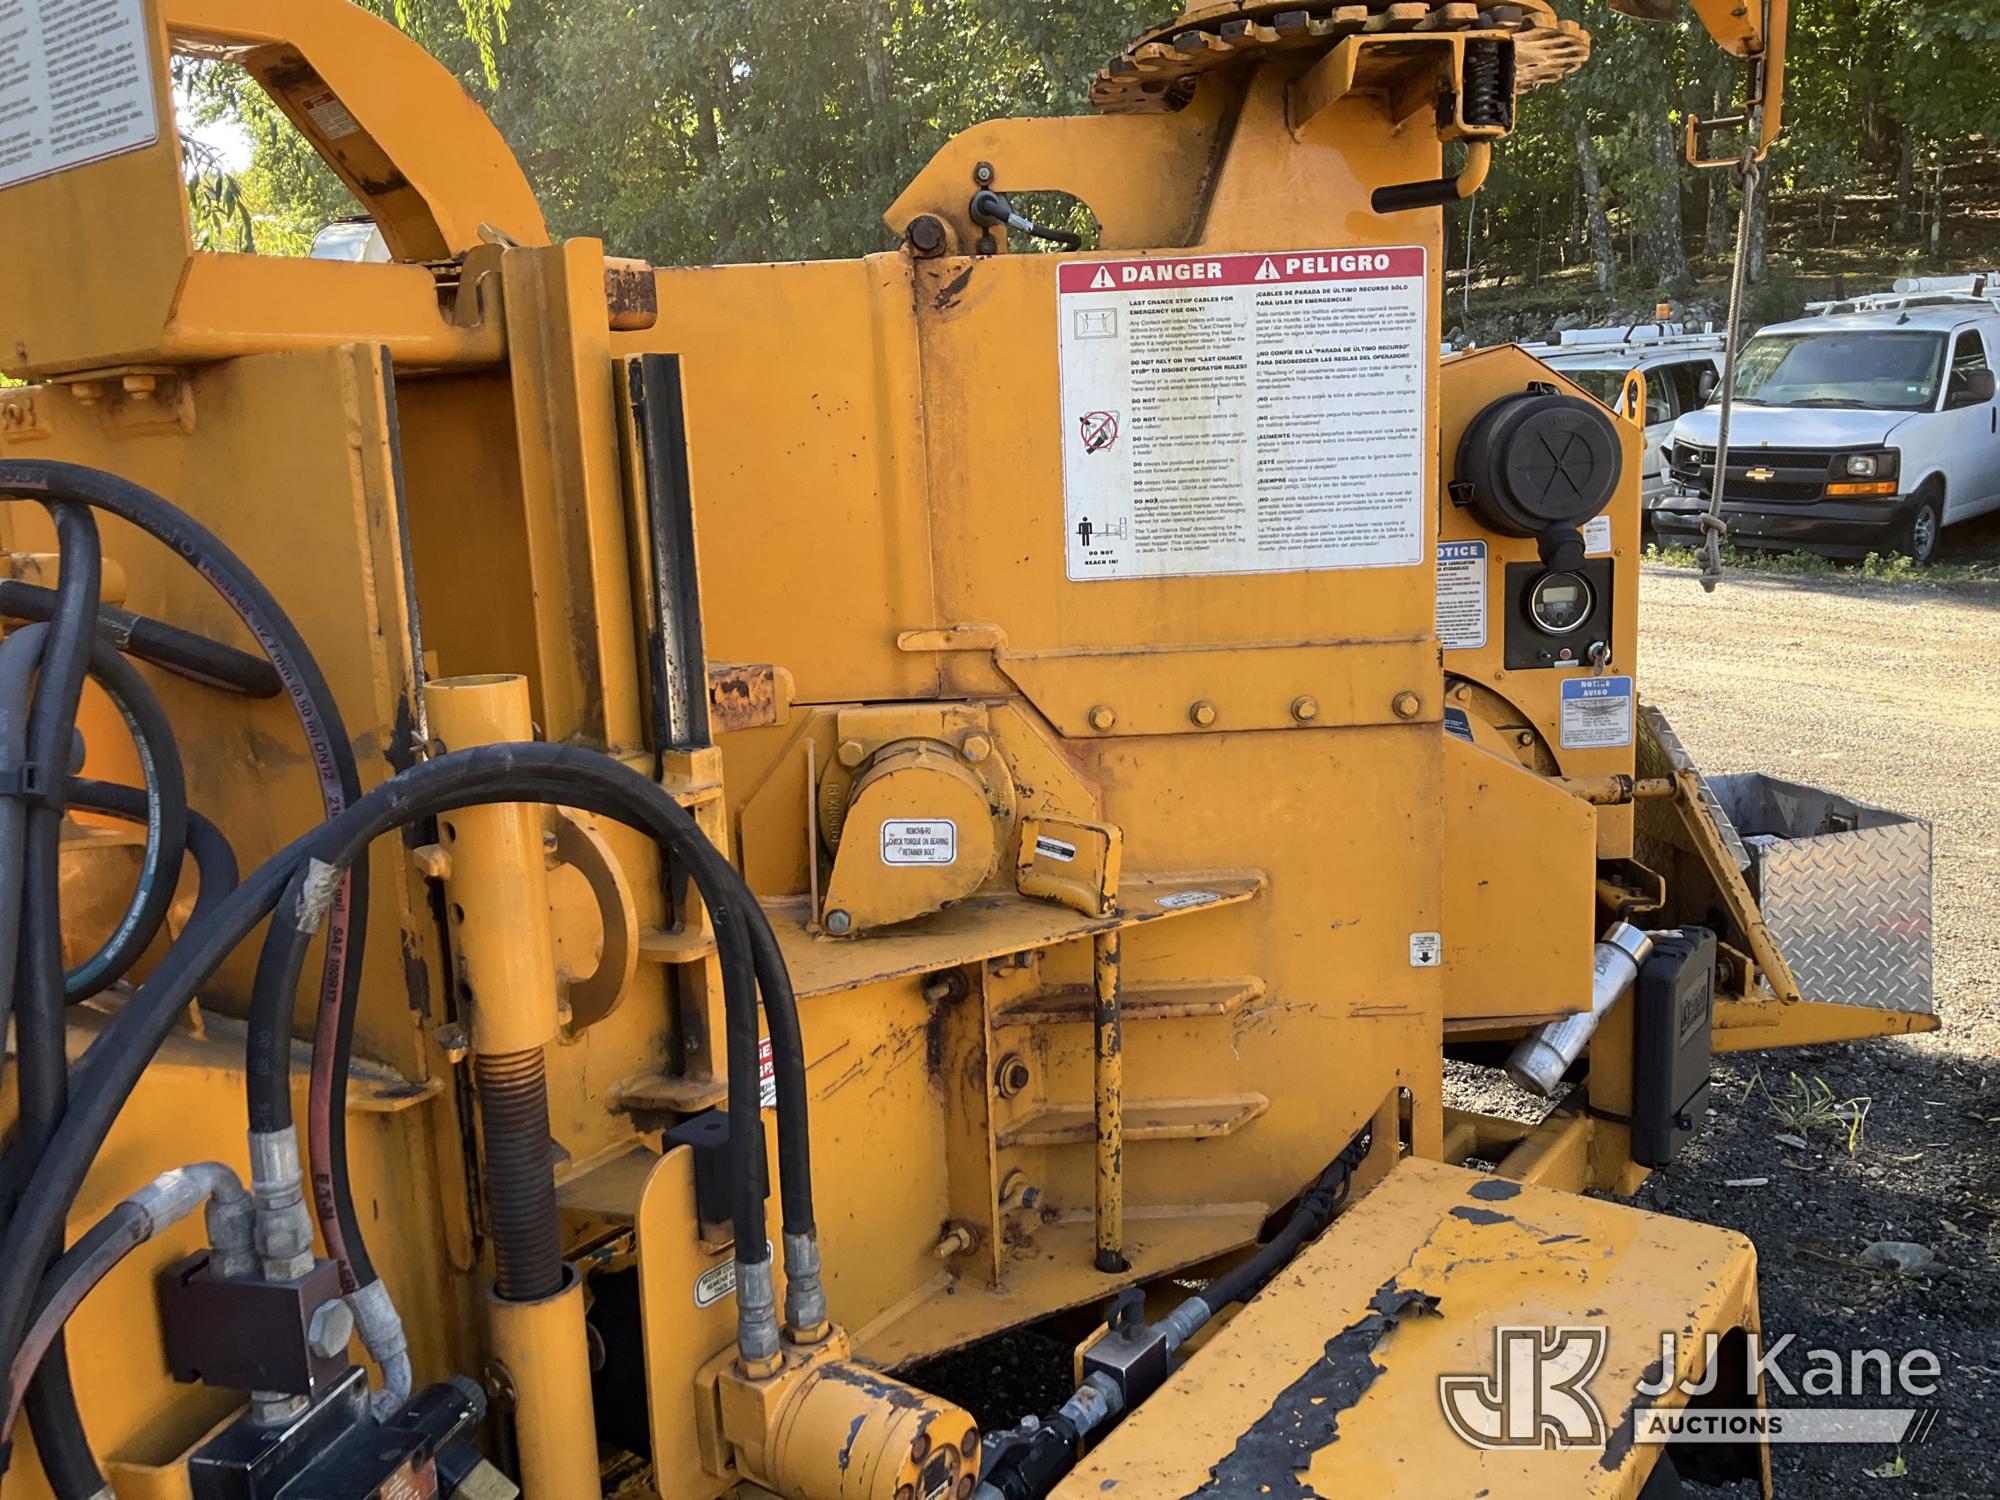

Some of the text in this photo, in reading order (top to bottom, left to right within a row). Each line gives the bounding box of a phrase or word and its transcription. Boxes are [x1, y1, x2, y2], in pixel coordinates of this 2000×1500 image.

[1286, 254, 1390, 275] PELIGRO
[1122, 262, 1222, 283] DANGER
[1437, 546, 1478, 558] OTICE
[1581, 680, 1610, 688] NOTICE
[1583, 689, 1607, 697] AVISO
[273, 653, 292, 682] mm
[291, 682, 312, 717] (0.50
[306, 719, 321, 744] in)
[314, 742, 334, 782] DN12
[889, 838, 902, 846] CHECK
[930, 837, 949, 845] BEARING
[903, 847, 935, 856] RETAINER BOLT
[331, 926, 344, 956] SAE
[702, 1270, 722, 1285] MOTOR
